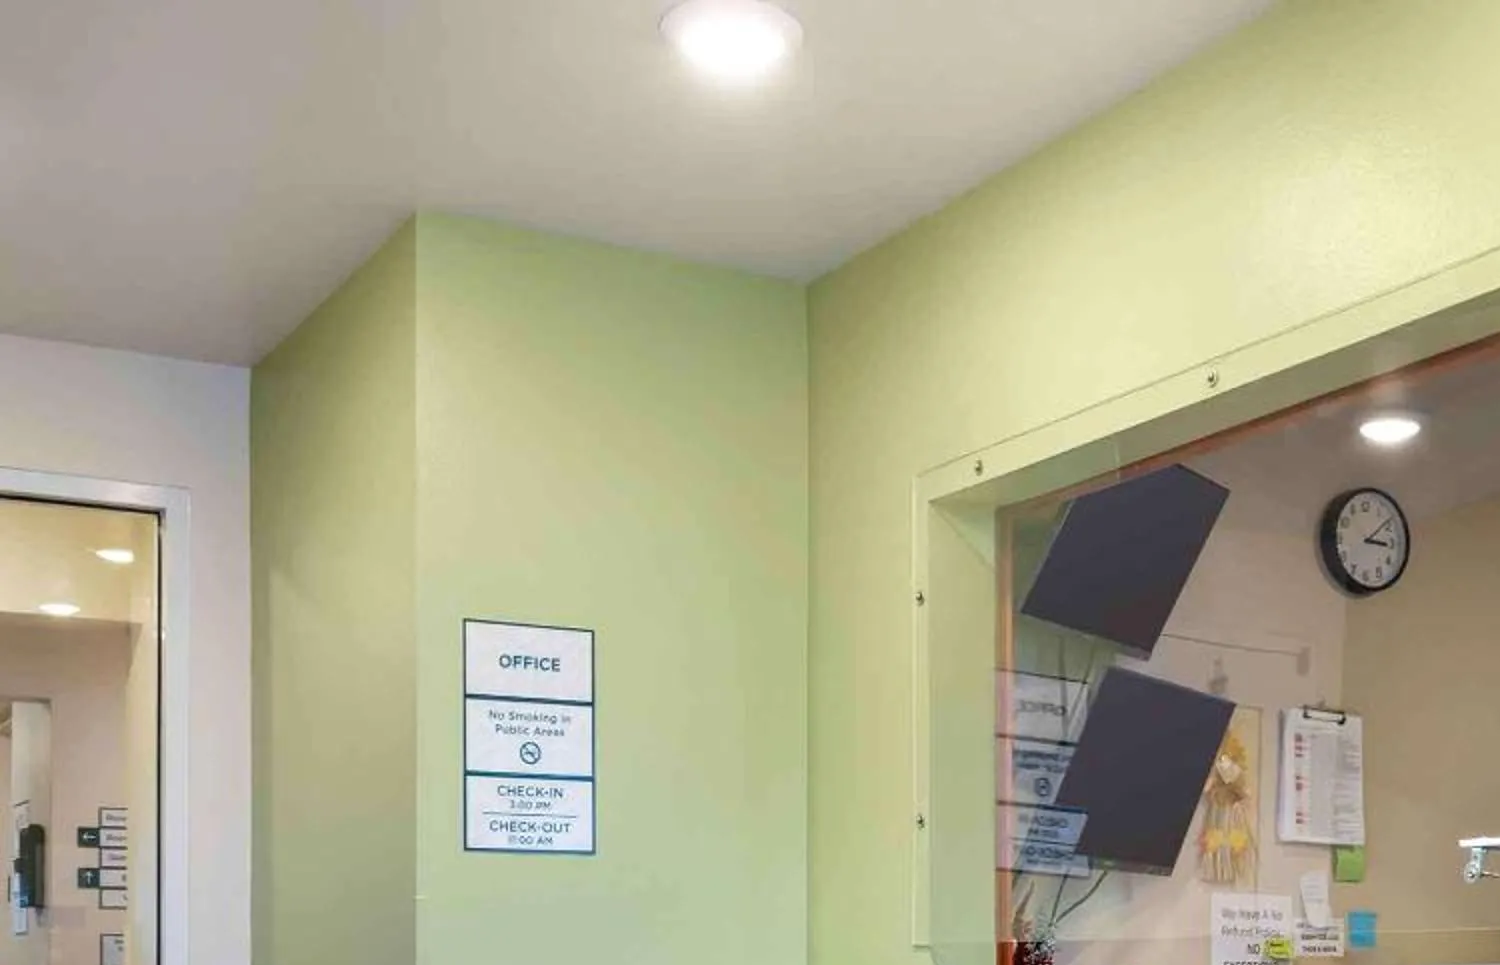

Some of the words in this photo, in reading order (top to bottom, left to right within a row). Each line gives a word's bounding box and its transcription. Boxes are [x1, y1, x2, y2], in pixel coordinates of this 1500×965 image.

[499, 654, 561, 672] OFFICE
[487, 709, 505, 721] No
[508, 711, 557, 725] Smoking
[495, 723, 530, 735] Public
[534, 726, 565, 737] Areas
[497, 785, 564, 799] CHECK-IN
[489, 819, 571, 834] CHECK-OUT
[1221, 924, 1254, 937] Refund
[1248, 943, 1261, 955] NO
